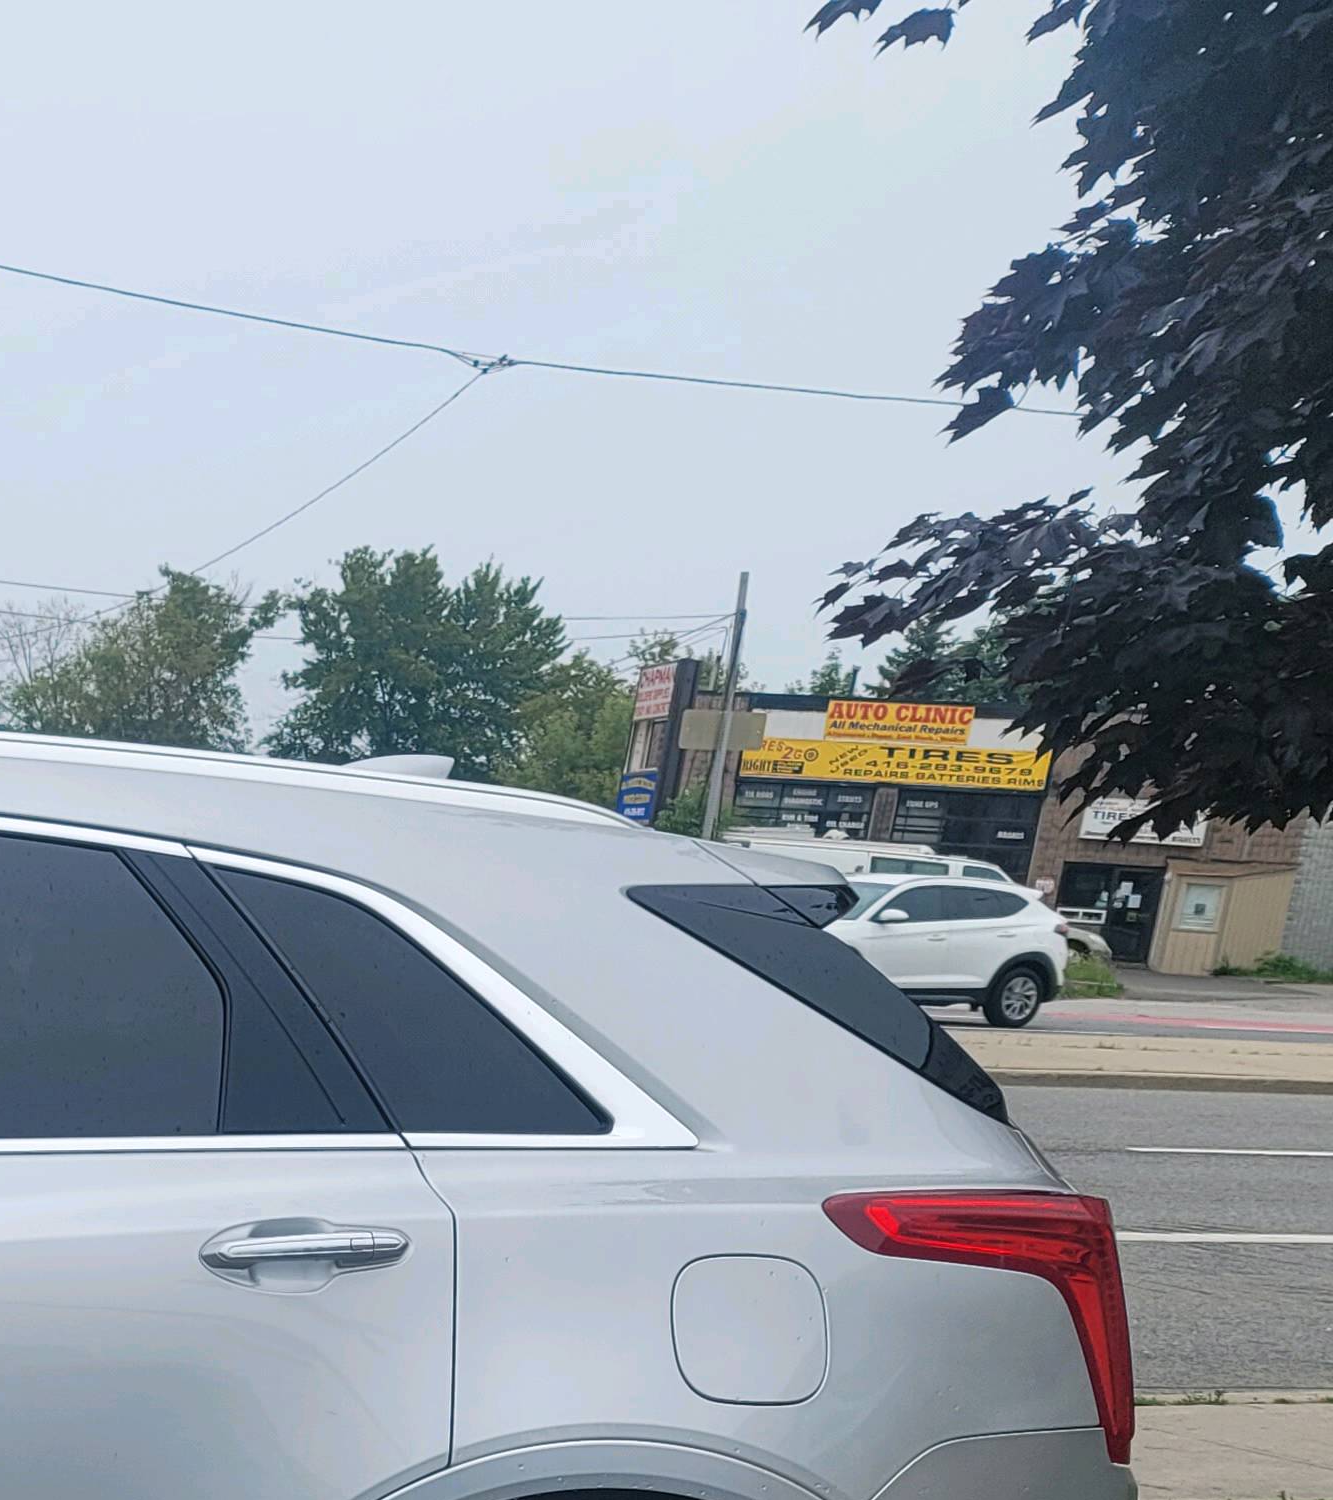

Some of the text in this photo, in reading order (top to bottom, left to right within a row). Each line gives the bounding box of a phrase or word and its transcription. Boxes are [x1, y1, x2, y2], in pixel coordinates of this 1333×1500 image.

[829, 702, 974, 725] AUTO CLINIC
[829, 720, 966, 736] All Mechanical Repairs
[829, 745, 859, 766] NEW
[879, 746, 1015, 765] TIRES
[843, 768, 1046, 788] REPAIRS BATTERIES RIMS
